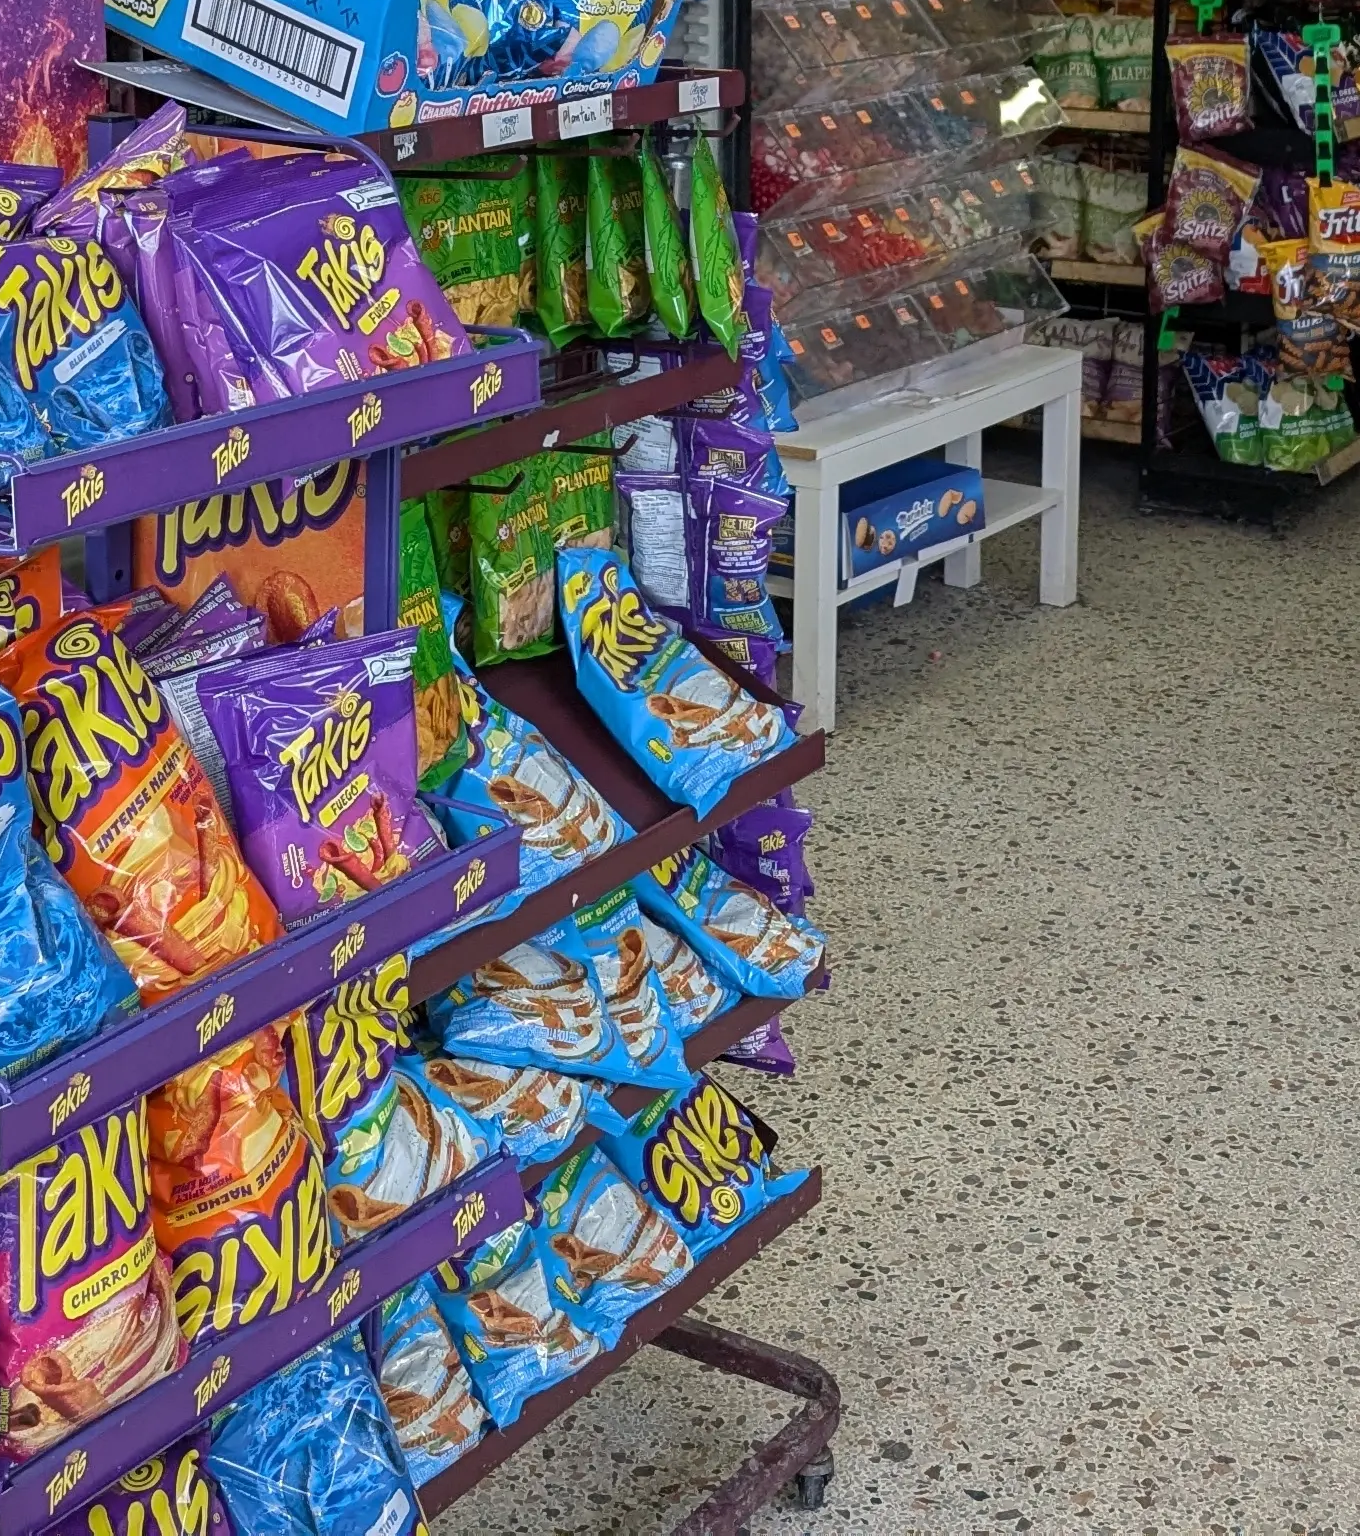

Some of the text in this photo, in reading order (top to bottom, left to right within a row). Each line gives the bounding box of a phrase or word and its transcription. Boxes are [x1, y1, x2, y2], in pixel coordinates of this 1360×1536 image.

[238, 52, 273, 77] 62851
[276, 70, 311, 94] 52320
[420, 101, 461, 120] CHARMS
[499, 124, 517, 141] MIX
[1197, 101, 1244, 128] Spitz
[397, 143, 415, 162] MIX
[437, 208, 513, 237] PLANTAIN
[1179, 219, 1228, 241] Spitz
[296, 215, 387, 331] Takis
[1166, 270, 1212, 301] Spitz
[68, 334, 107, 371] BLUE HEAT
[469, 364, 504, 414] Takis
[347, 395, 384, 447] Takis
[211, 430, 252, 485] Takis
[62, 466, 106, 527] Takis
[281, 693, 374, 825] Takis
[96, 788, 152, 854] INTENSE
[331, 787, 356, 815] FUEGO
[758, 830, 787, 854] Takis
[452, 858, 488, 913] Takis
[596, 889, 628, 917] RANCH
[329, 921, 368, 979] Takis
[194, 993, 237, 1053] Takis
[48, 1073, 91, 1135] Takis
[197, 1184, 252, 1216] NACHO
[452, 1191, 485, 1246] Takis
[71, 1264, 129, 1309] CHURRO
[327, 1265, 361, 1327] Takis
[193, 1356, 232, 1417] Takis
[46, 1448, 89, 1516] Takis
